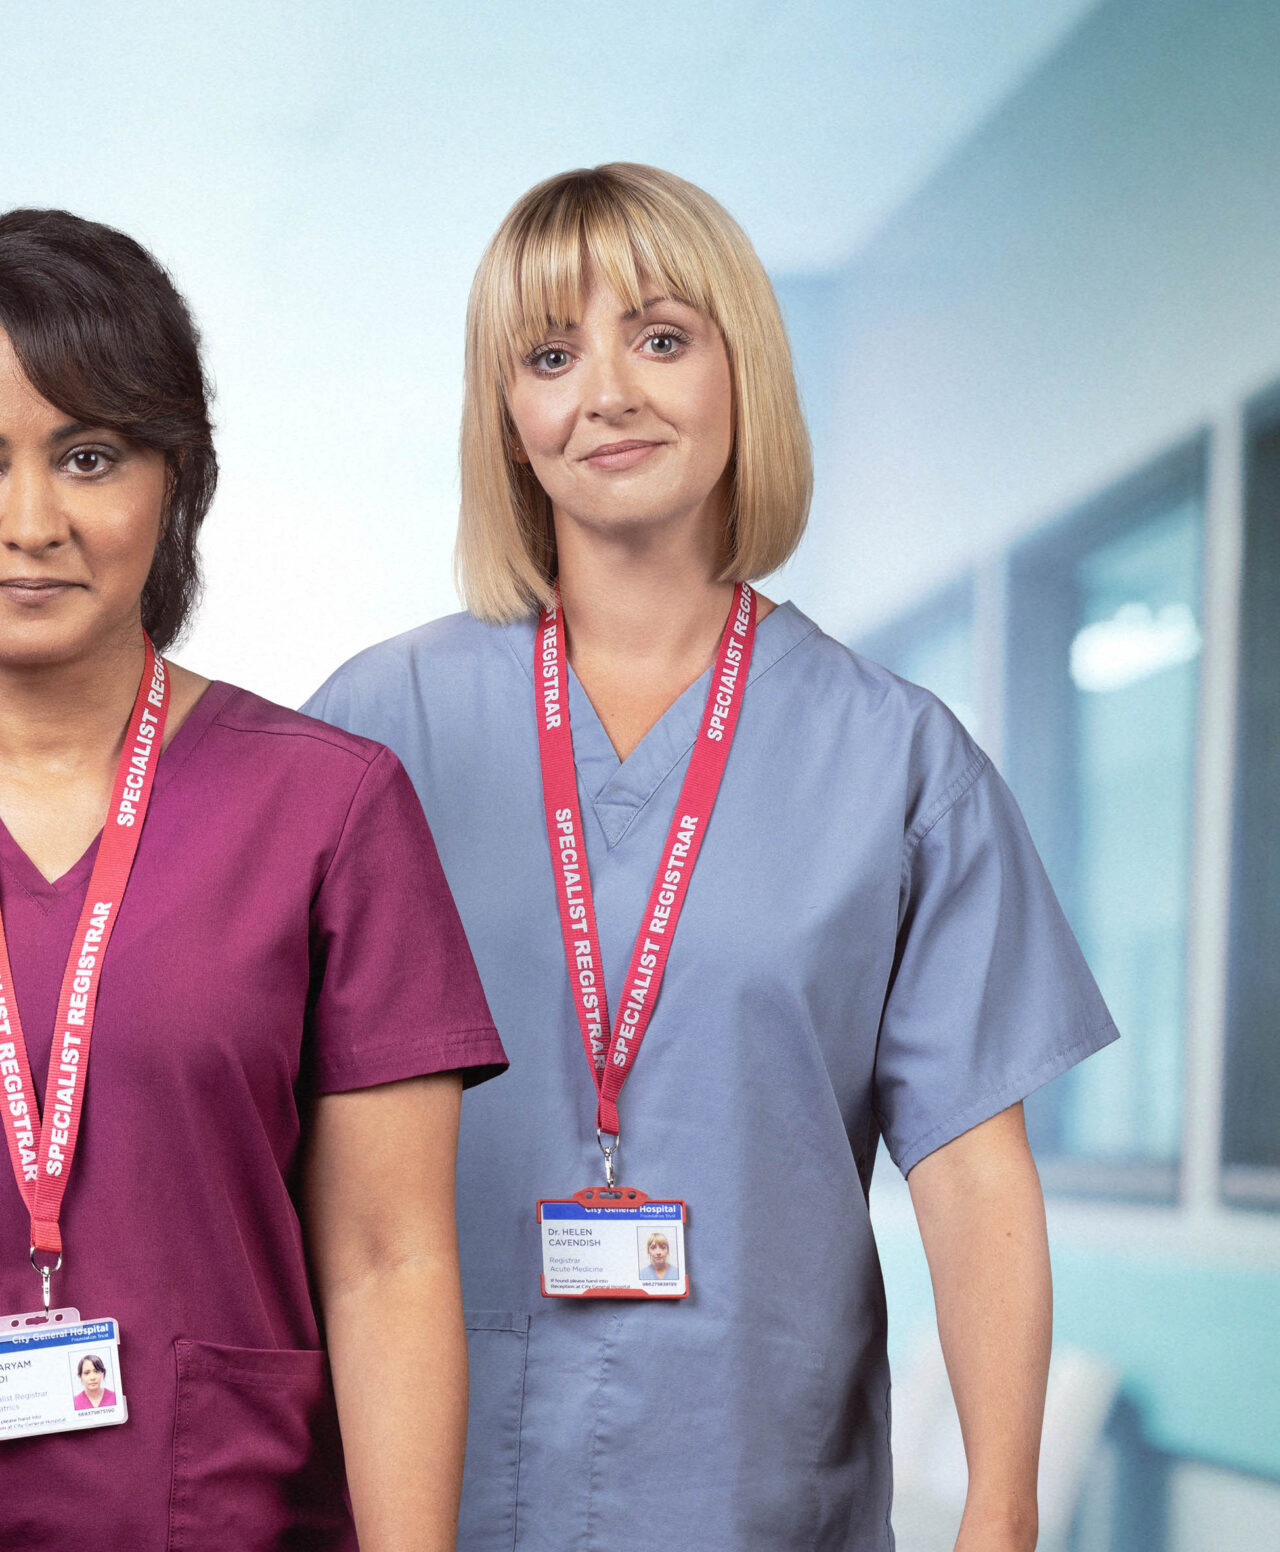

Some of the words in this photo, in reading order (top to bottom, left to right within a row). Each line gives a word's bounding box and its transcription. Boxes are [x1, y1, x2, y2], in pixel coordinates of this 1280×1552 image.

[542, 624, 562, 731] REGISTRAR
[706, 637, 744, 742] SPECIALIST
[116, 708, 159, 828] SPECIALIST
[555, 807, 589, 933] SPECIALIST
[573, 939, 607, 1070] REGISTRAR
[612, 937, 661, 1067] SPECIALIST
[649, 814, 699, 934] REGISTRAR
[46, 1031, 82, 1177] SPECIALIST
[67, 901, 113, 1026] REGISTRAR
[548, 1228, 560, 1236] Dr.
[562, 1228, 593, 1236] HELEN
[549, 1238, 601, 1246] CAVENDISH
[549, 1256, 581, 1264] Registrar
[639, 1204, 676, 1214] Hospital
[11, 1335, 30, 1344] City
[33, 1330, 68, 1342] General
[70, 1323, 109, 1337] Hospital
